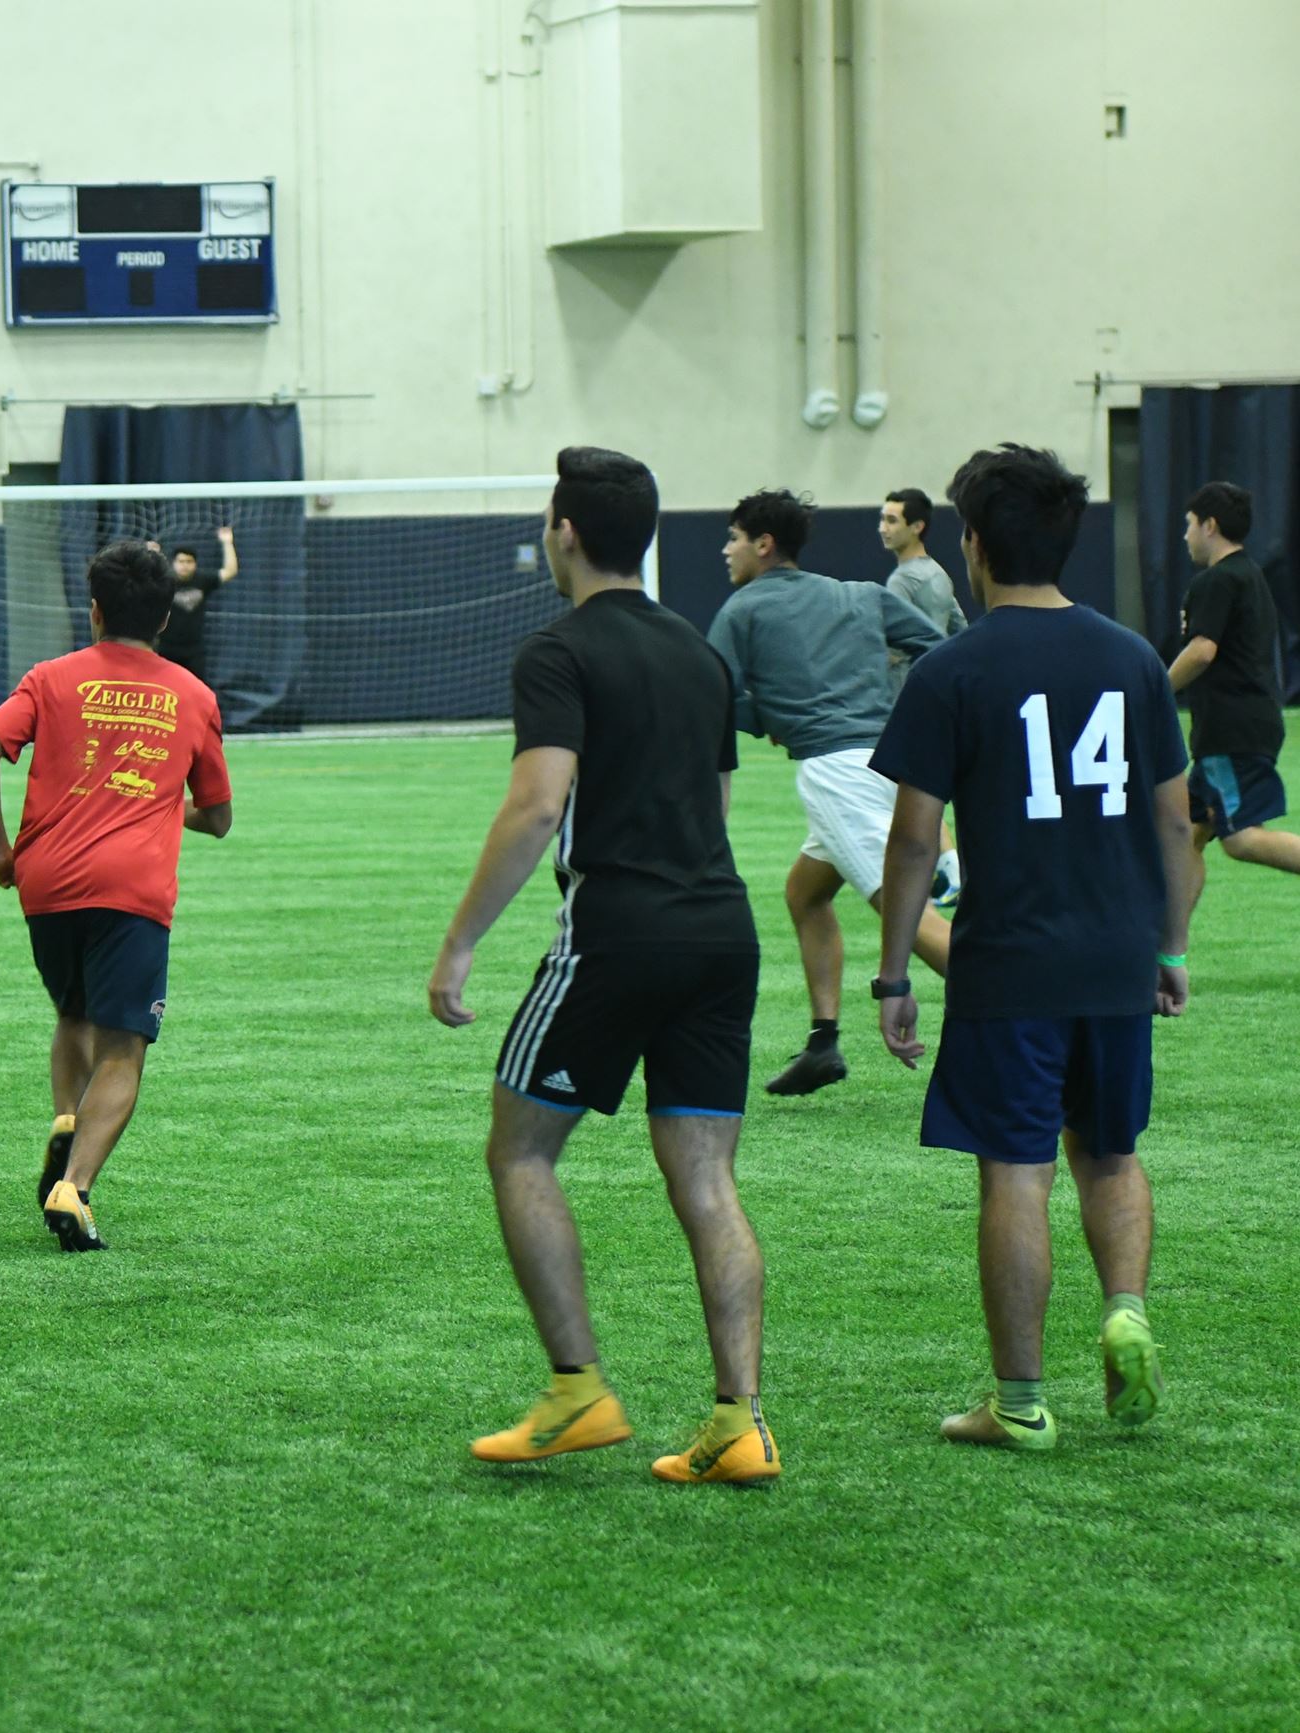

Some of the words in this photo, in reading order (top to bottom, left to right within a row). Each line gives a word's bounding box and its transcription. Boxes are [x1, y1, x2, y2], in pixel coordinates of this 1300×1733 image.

[22, 240, 80, 262] HOME
[116, 251, 166, 267] PERIOD
[198, 238, 262, 261] GUEST
[77, 680, 179, 717] ZEIGLER
[1019, 691, 1129, 819] 14
